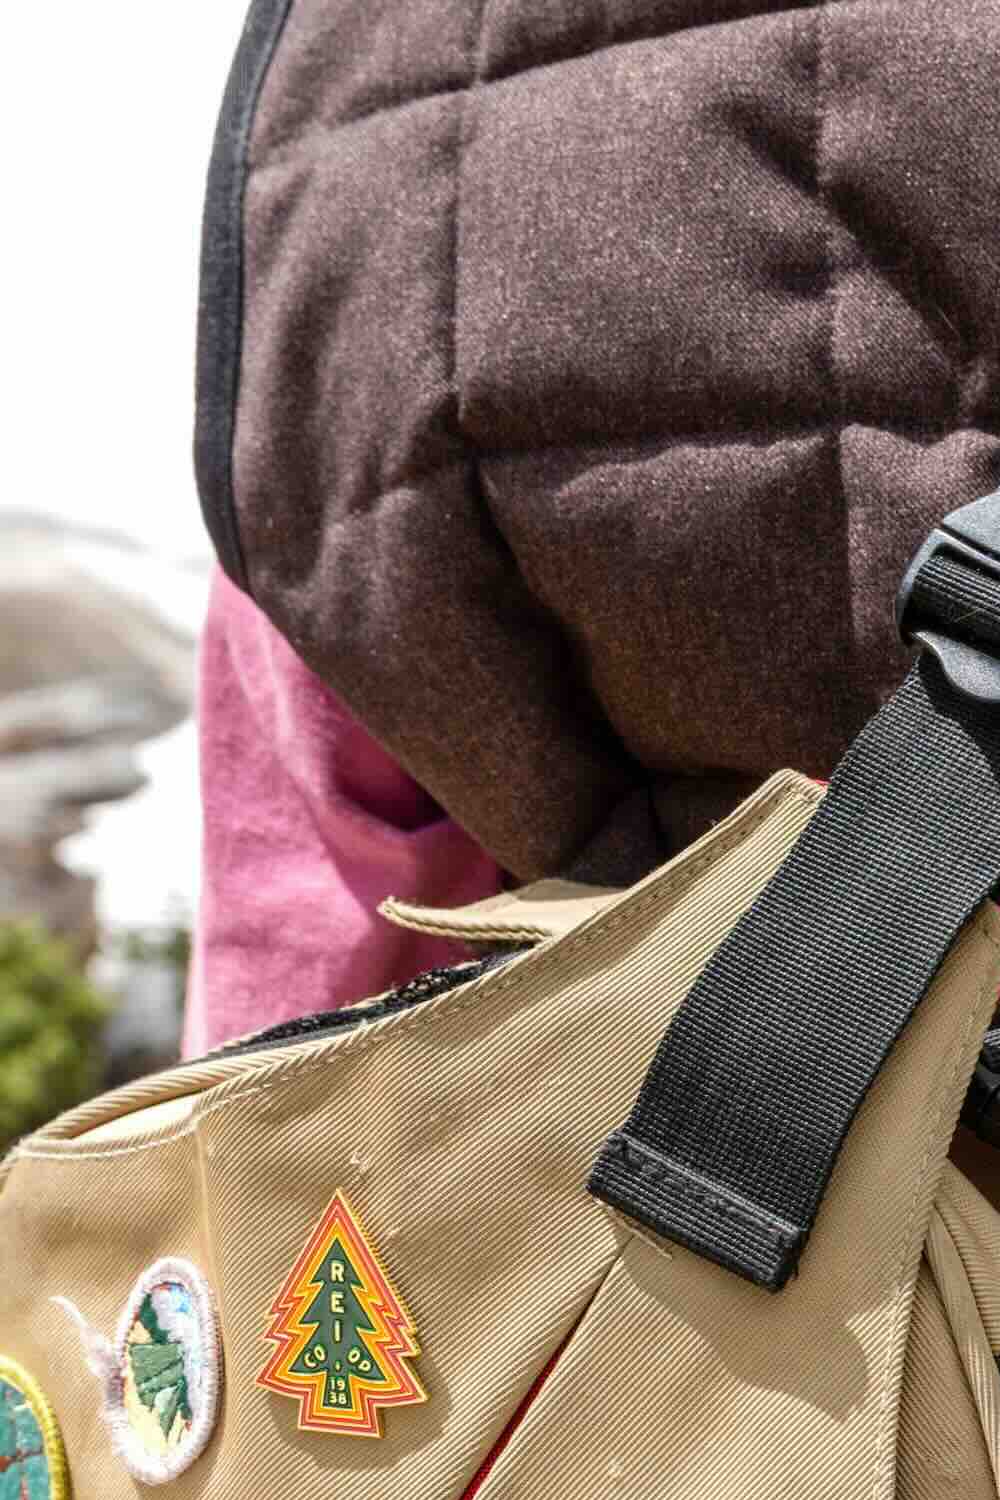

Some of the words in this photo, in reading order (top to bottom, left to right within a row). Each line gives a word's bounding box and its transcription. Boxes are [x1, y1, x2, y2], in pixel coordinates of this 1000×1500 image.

[330, 1260, 345, 1343] REI
[303, 1345, 327, 1368] CO
[347, 1347, 372, 1373] OP
